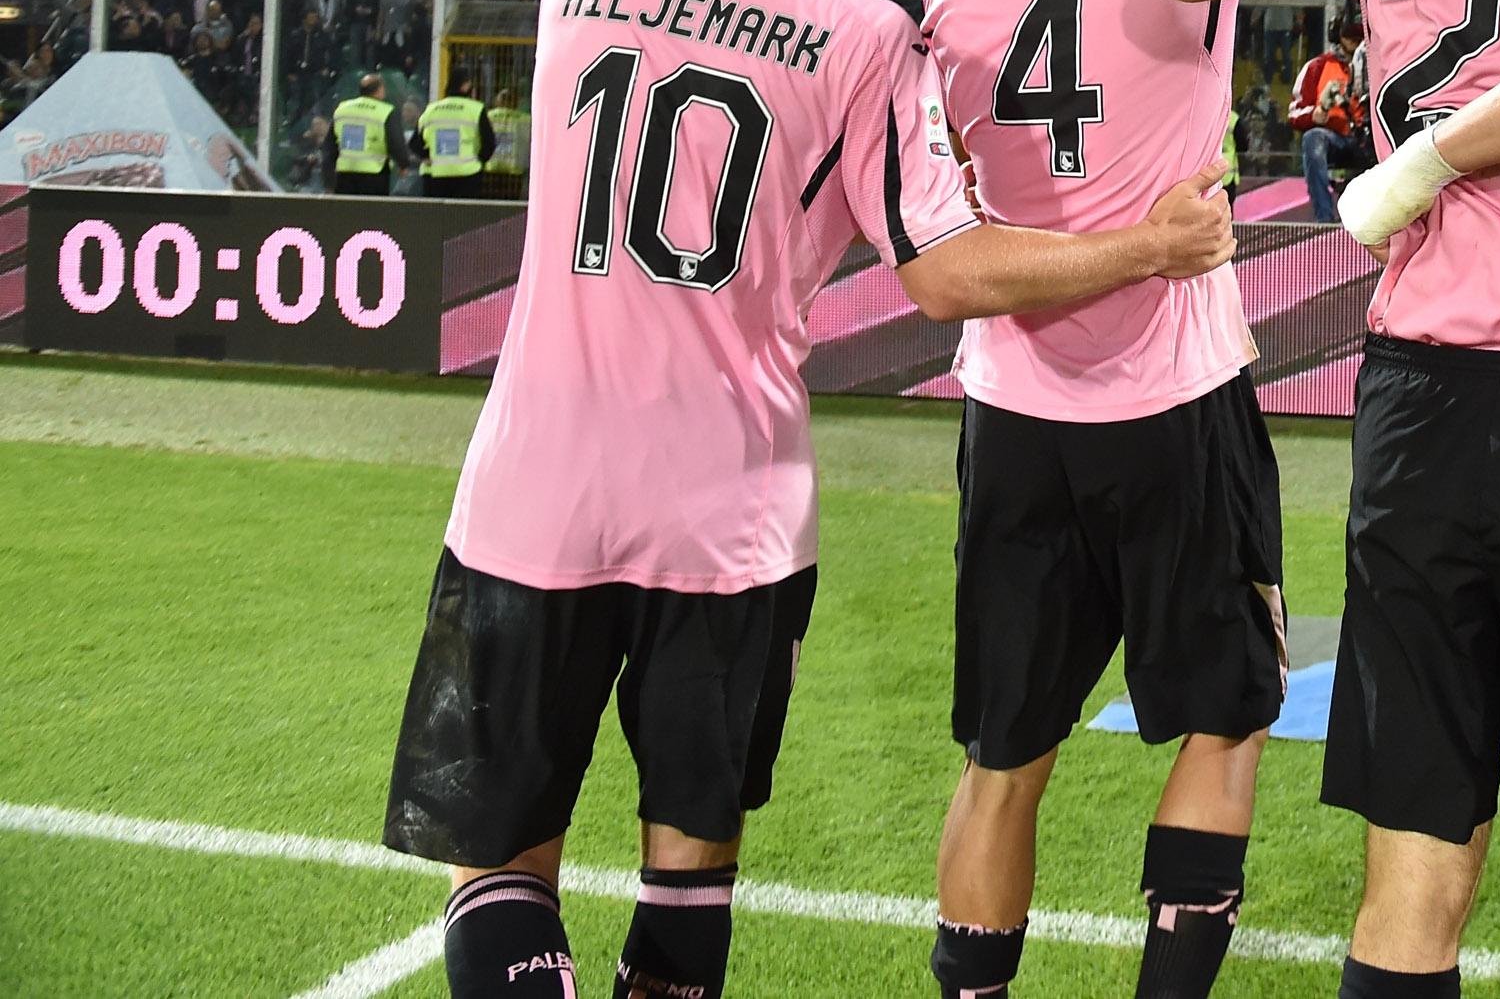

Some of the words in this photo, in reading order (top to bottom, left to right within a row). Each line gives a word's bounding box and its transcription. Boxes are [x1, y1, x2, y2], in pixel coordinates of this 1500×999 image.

[24, 131, 169, 180] MAXIBON
[567, 46, 775, 293] 10
[57, 218, 407, 329] 00:00
